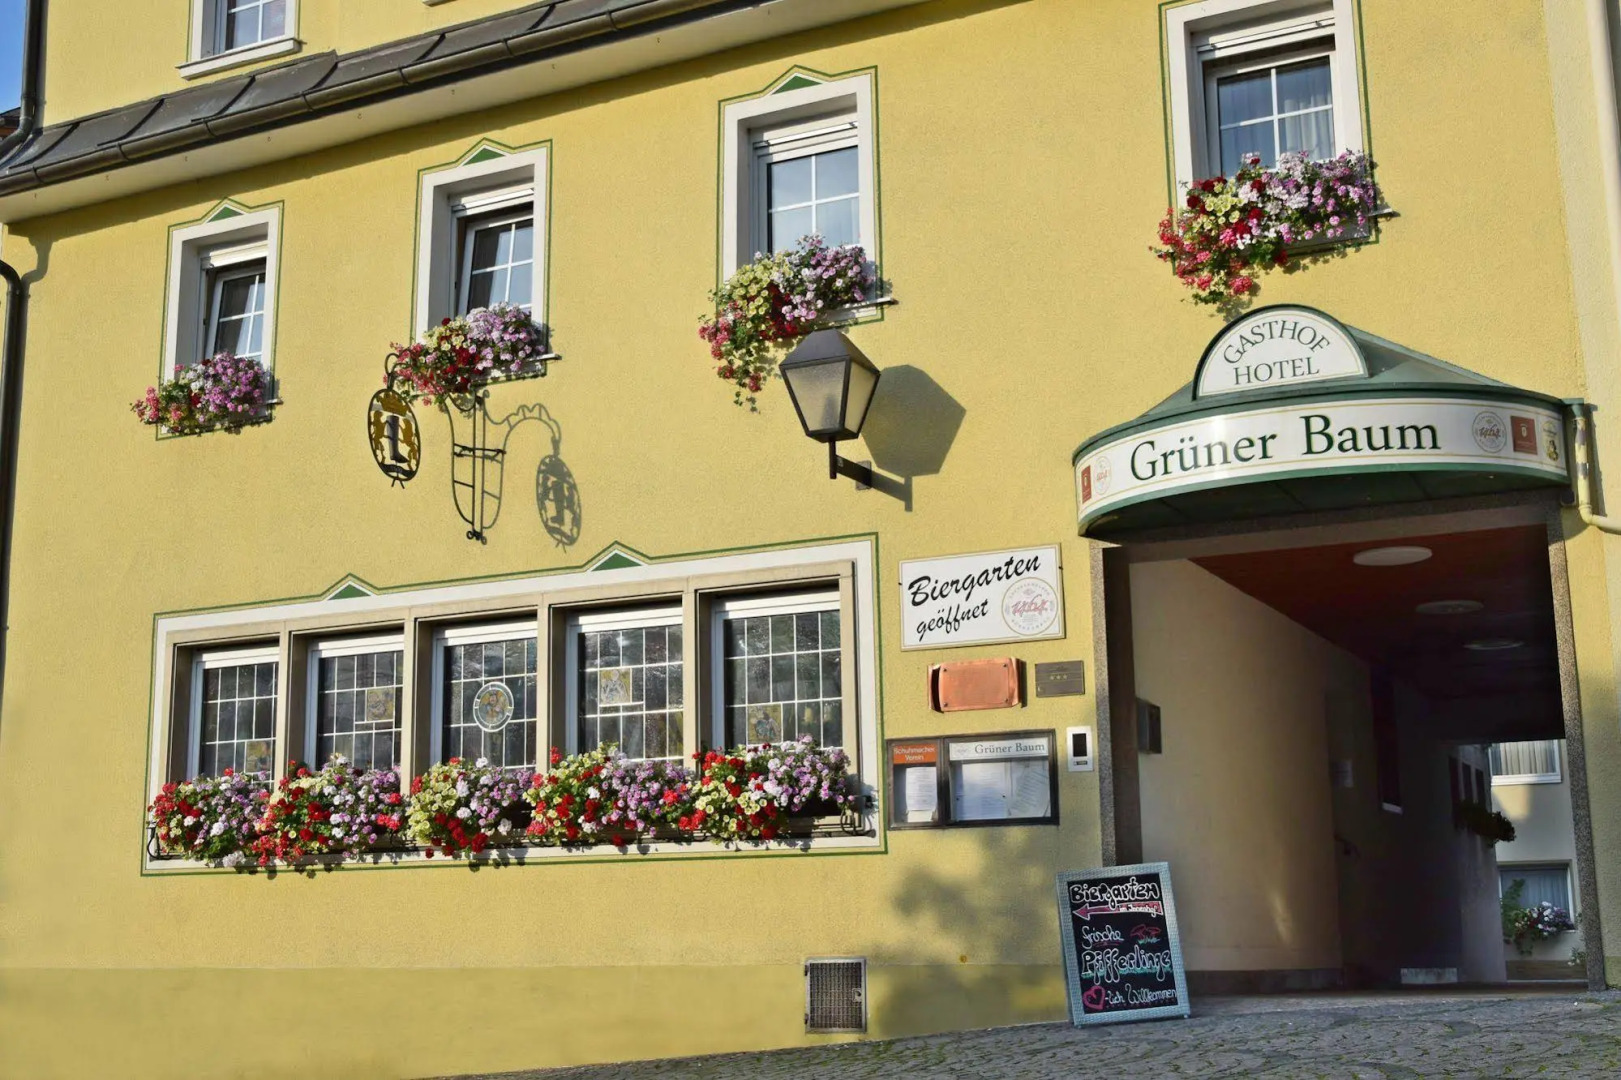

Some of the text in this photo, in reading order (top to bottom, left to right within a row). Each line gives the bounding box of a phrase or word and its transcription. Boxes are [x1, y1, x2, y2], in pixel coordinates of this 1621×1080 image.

[1223, 320, 1330, 364] GASTHOF
[1233, 357, 1320, 385] HOTEL
[1130, 435, 1277, 481] Grüner
[1299, 414, 1442, 455] Baum
[908, 555, 1041, 607] Biergarten
[916, 598, 989, 642] geöffnet
[974, 743, 1012, 754] Grüner
[1015, 742, 1045, 752] Baum
[1069, 877, 1160, 910] Biergarten
[1081, 924, 1125, 949] frische
[1125, 983, 1177, 1004] Willkommen
